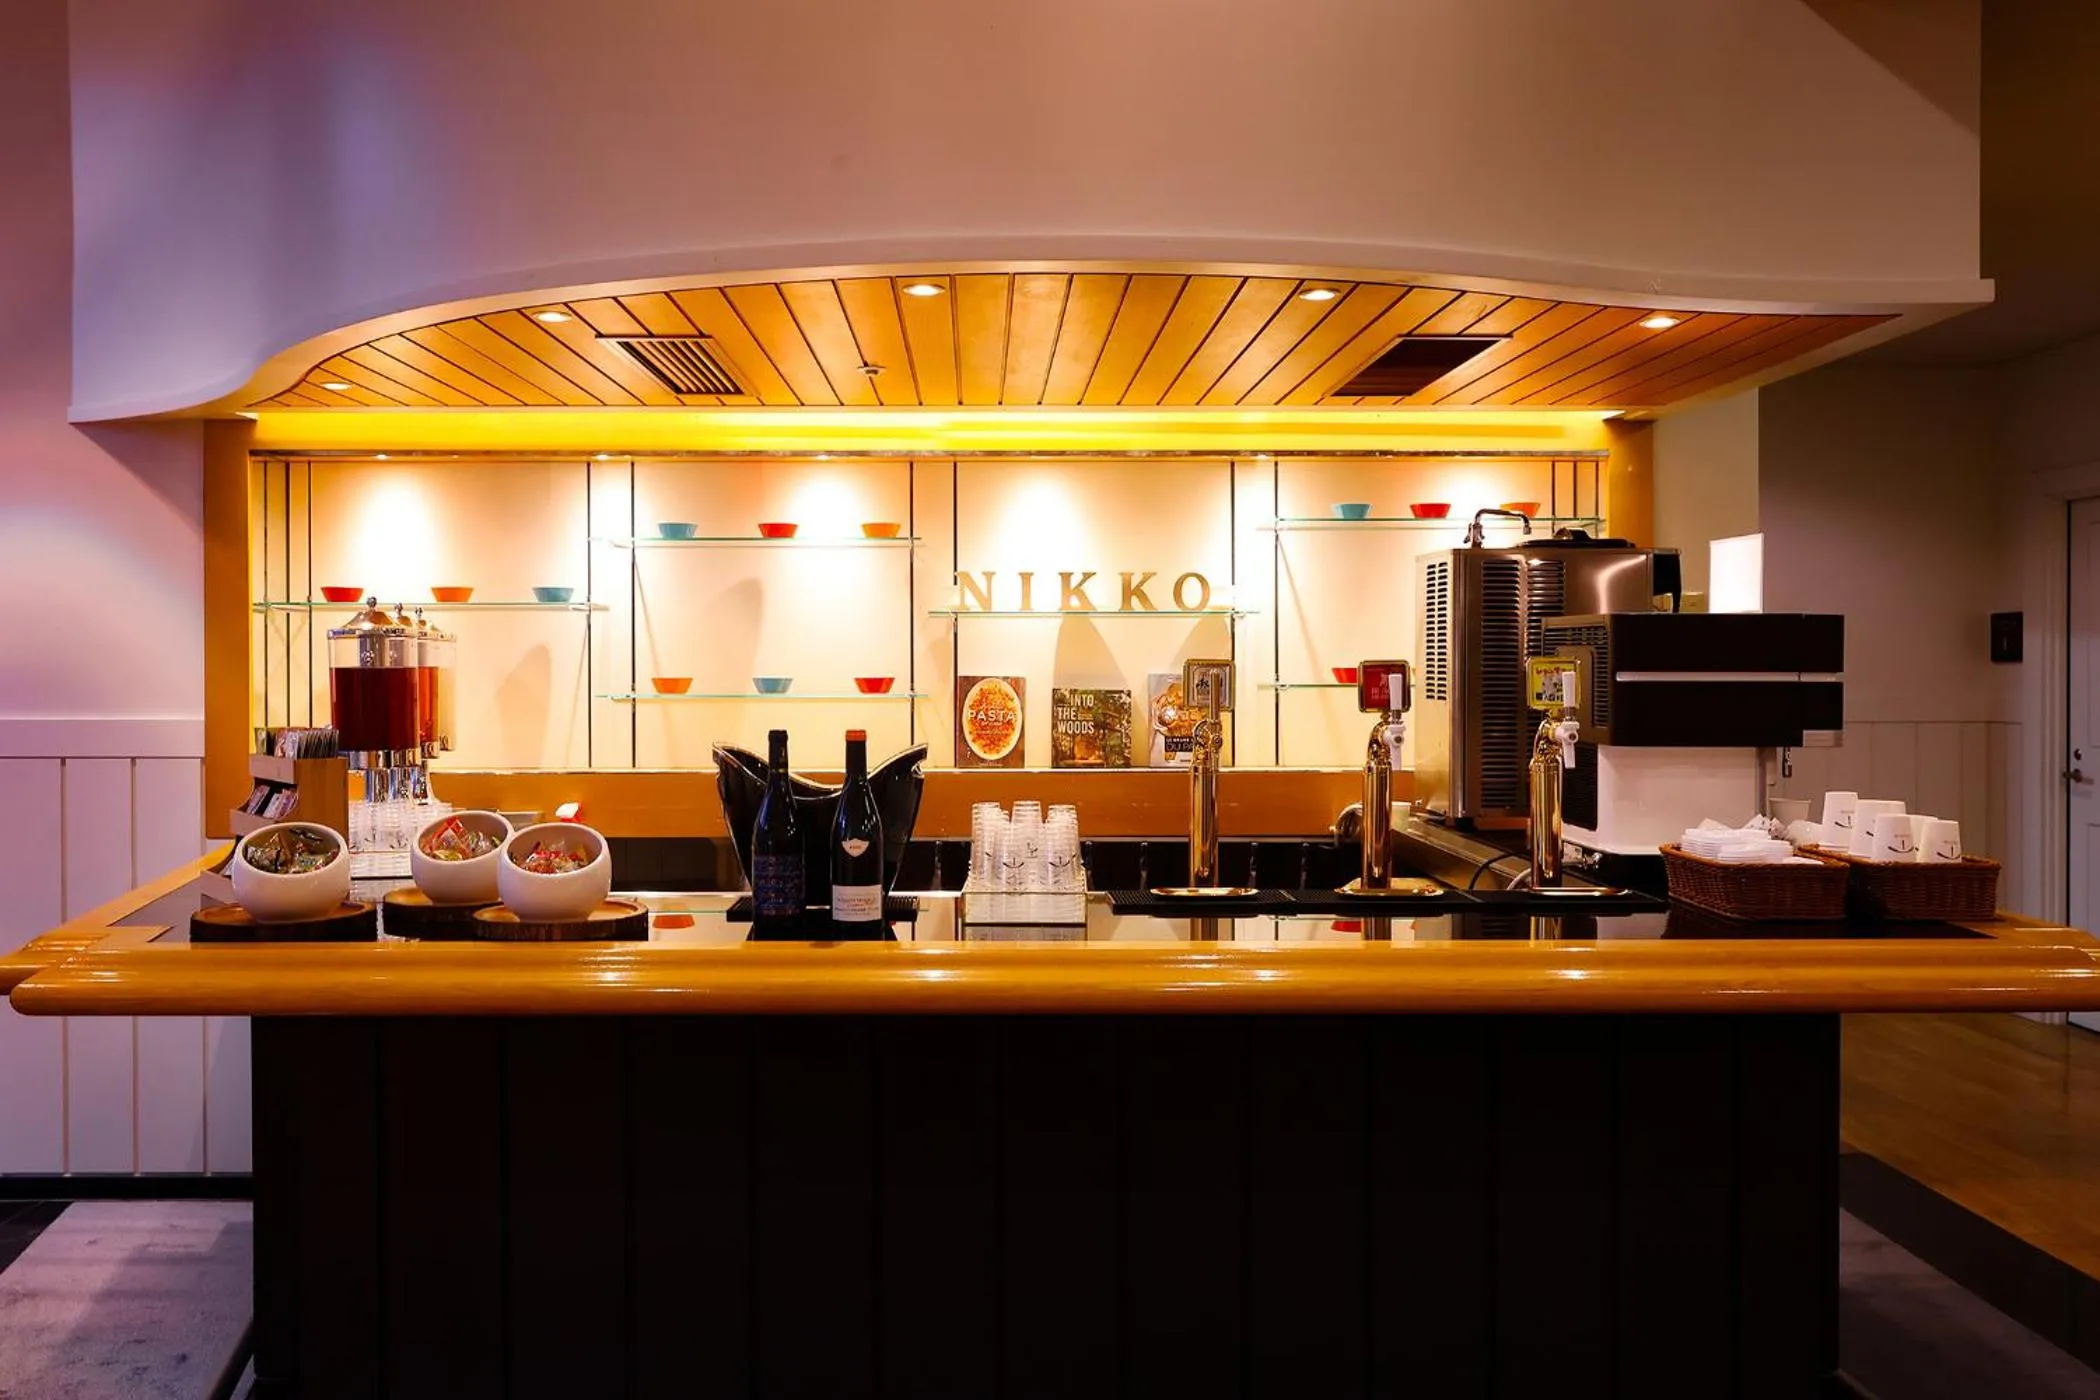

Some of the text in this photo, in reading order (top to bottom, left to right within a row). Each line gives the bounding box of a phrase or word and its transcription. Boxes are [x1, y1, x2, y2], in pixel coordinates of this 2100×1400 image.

[956, 571, 1211, 611] NIKKO
[1070, 694, 1094, 707] INTO
[968, 709, 1016, 722] PASTA
[1057, 707, 1077, 720] THE
[1057, 720, 1095, 734] WOODS
